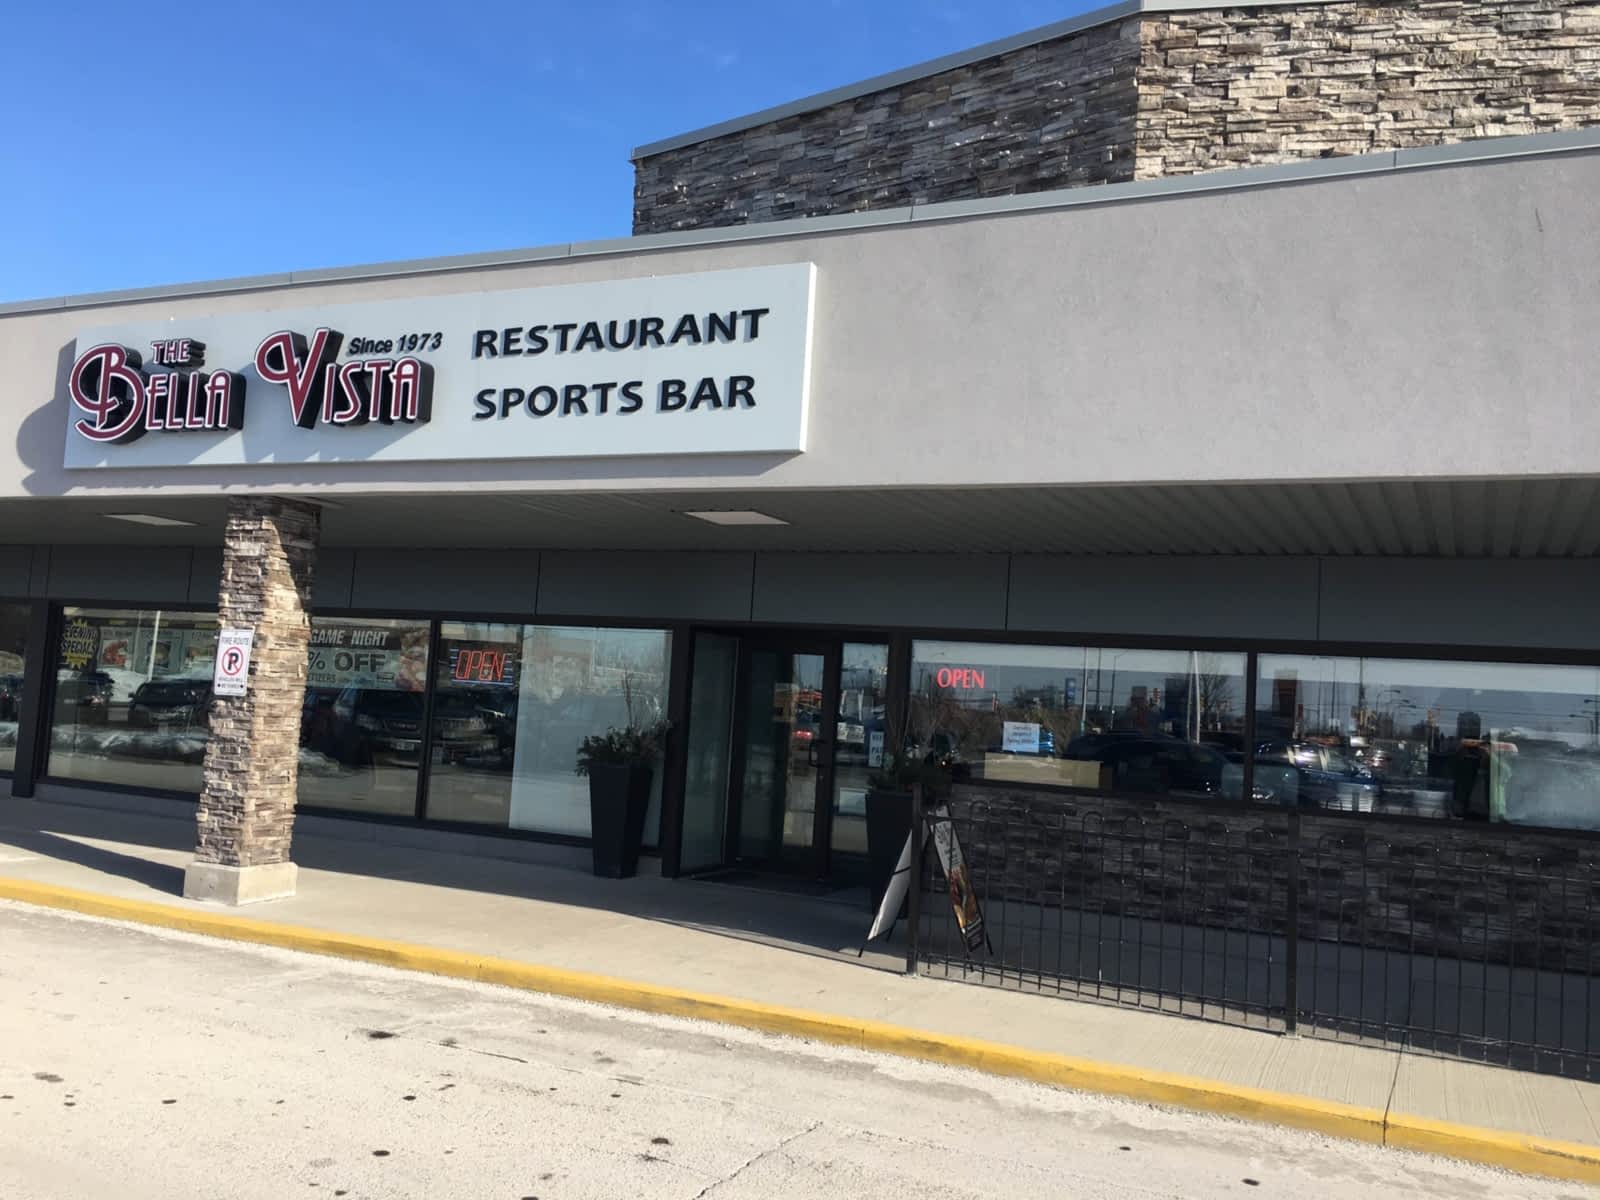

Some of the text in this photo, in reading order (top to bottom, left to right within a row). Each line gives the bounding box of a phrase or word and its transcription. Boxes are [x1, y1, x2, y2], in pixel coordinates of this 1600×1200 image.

[348, 332, 443, 355] Since 1973
[474, 307, 770, 357] RESTAURANT
[150, 338, 193, 365] THE
[254, 327, 424, 425] VISTA
[474, 375, 757, 419] SPORTS BAR
[309, 628, 390, 647] GAME NIGHT
[334, 651, 387, 673] OFF
[456, 650, 506, 680] OPEN
[936, 667, 986, 689] OPEN
